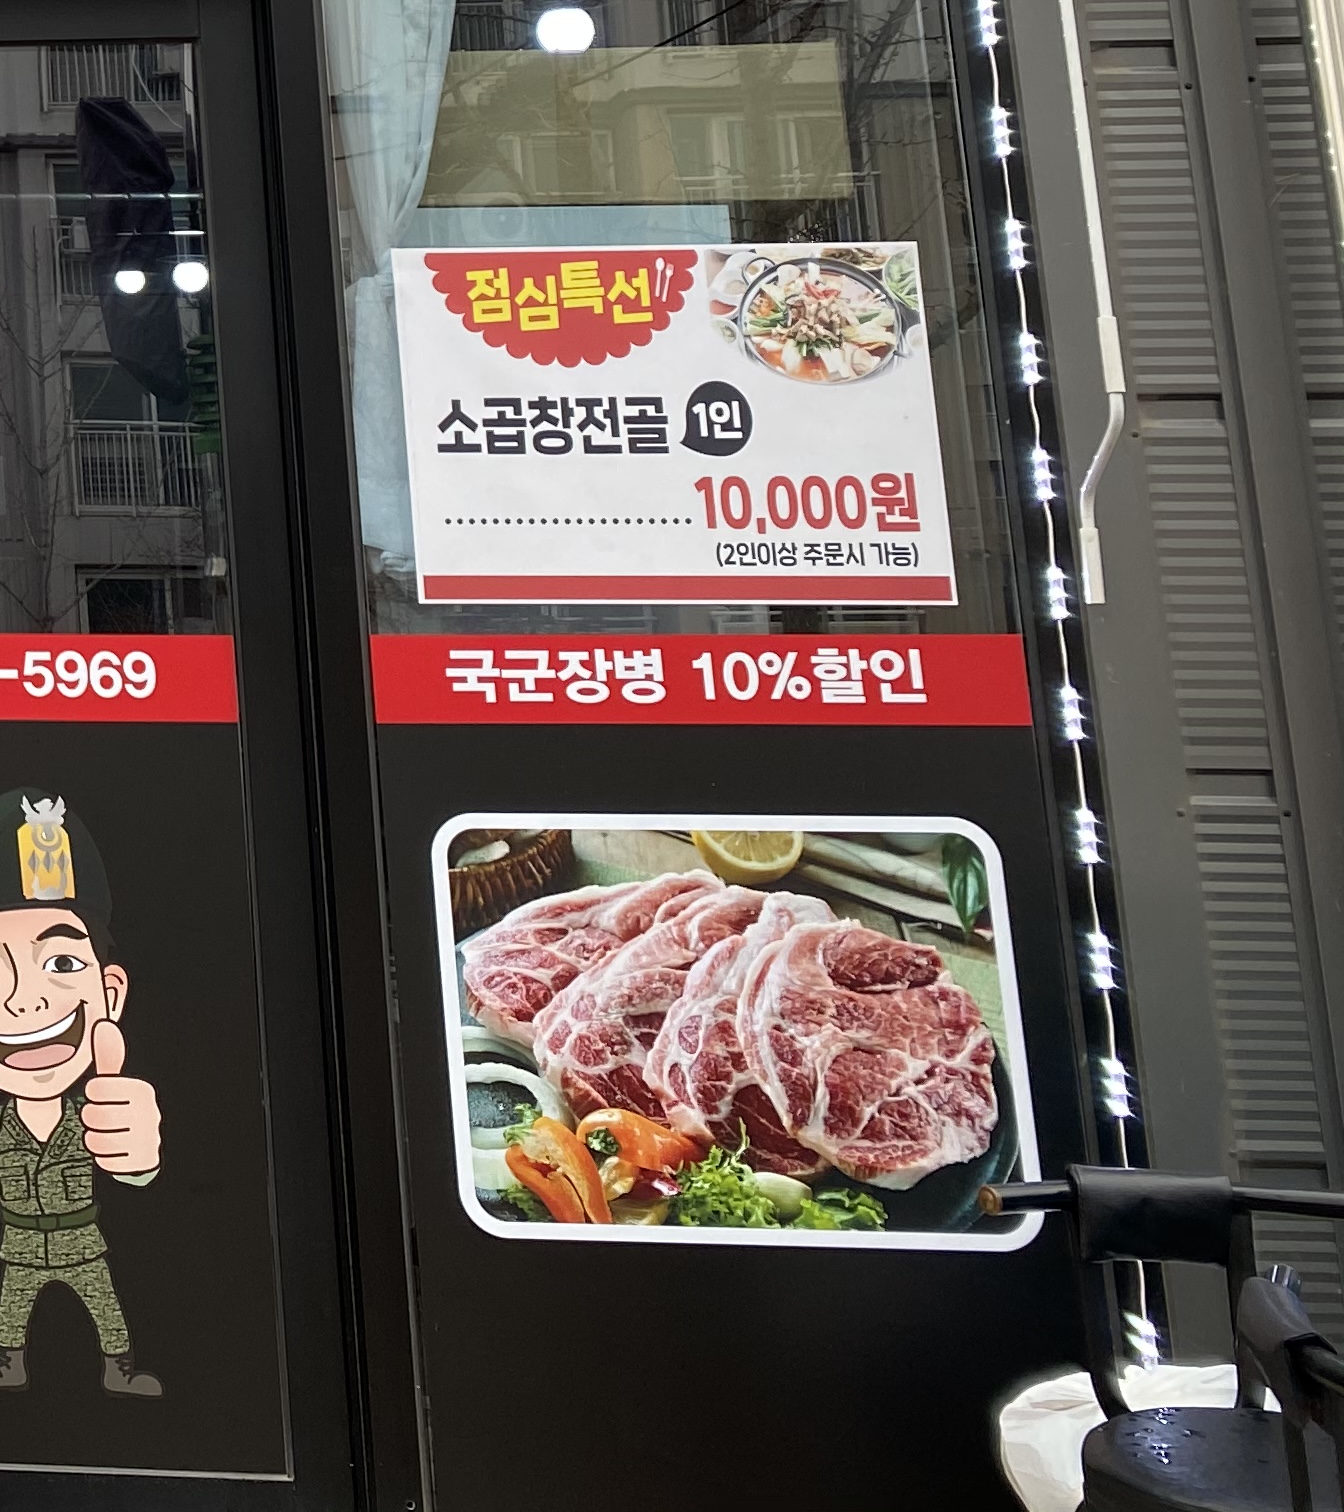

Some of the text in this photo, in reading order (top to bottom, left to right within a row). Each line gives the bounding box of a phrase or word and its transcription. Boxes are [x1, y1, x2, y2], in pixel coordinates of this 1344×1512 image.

[464, 259, 654, 332] 점심특선
[436, 395, 744, 456] 소곱창전골 1인
[694, 472, 921, 535] 10,000원
[716, 541, 920, 567] (2인이상 주문시 가능)
[444, 647, 928, 705] 국군장병 10%할인
